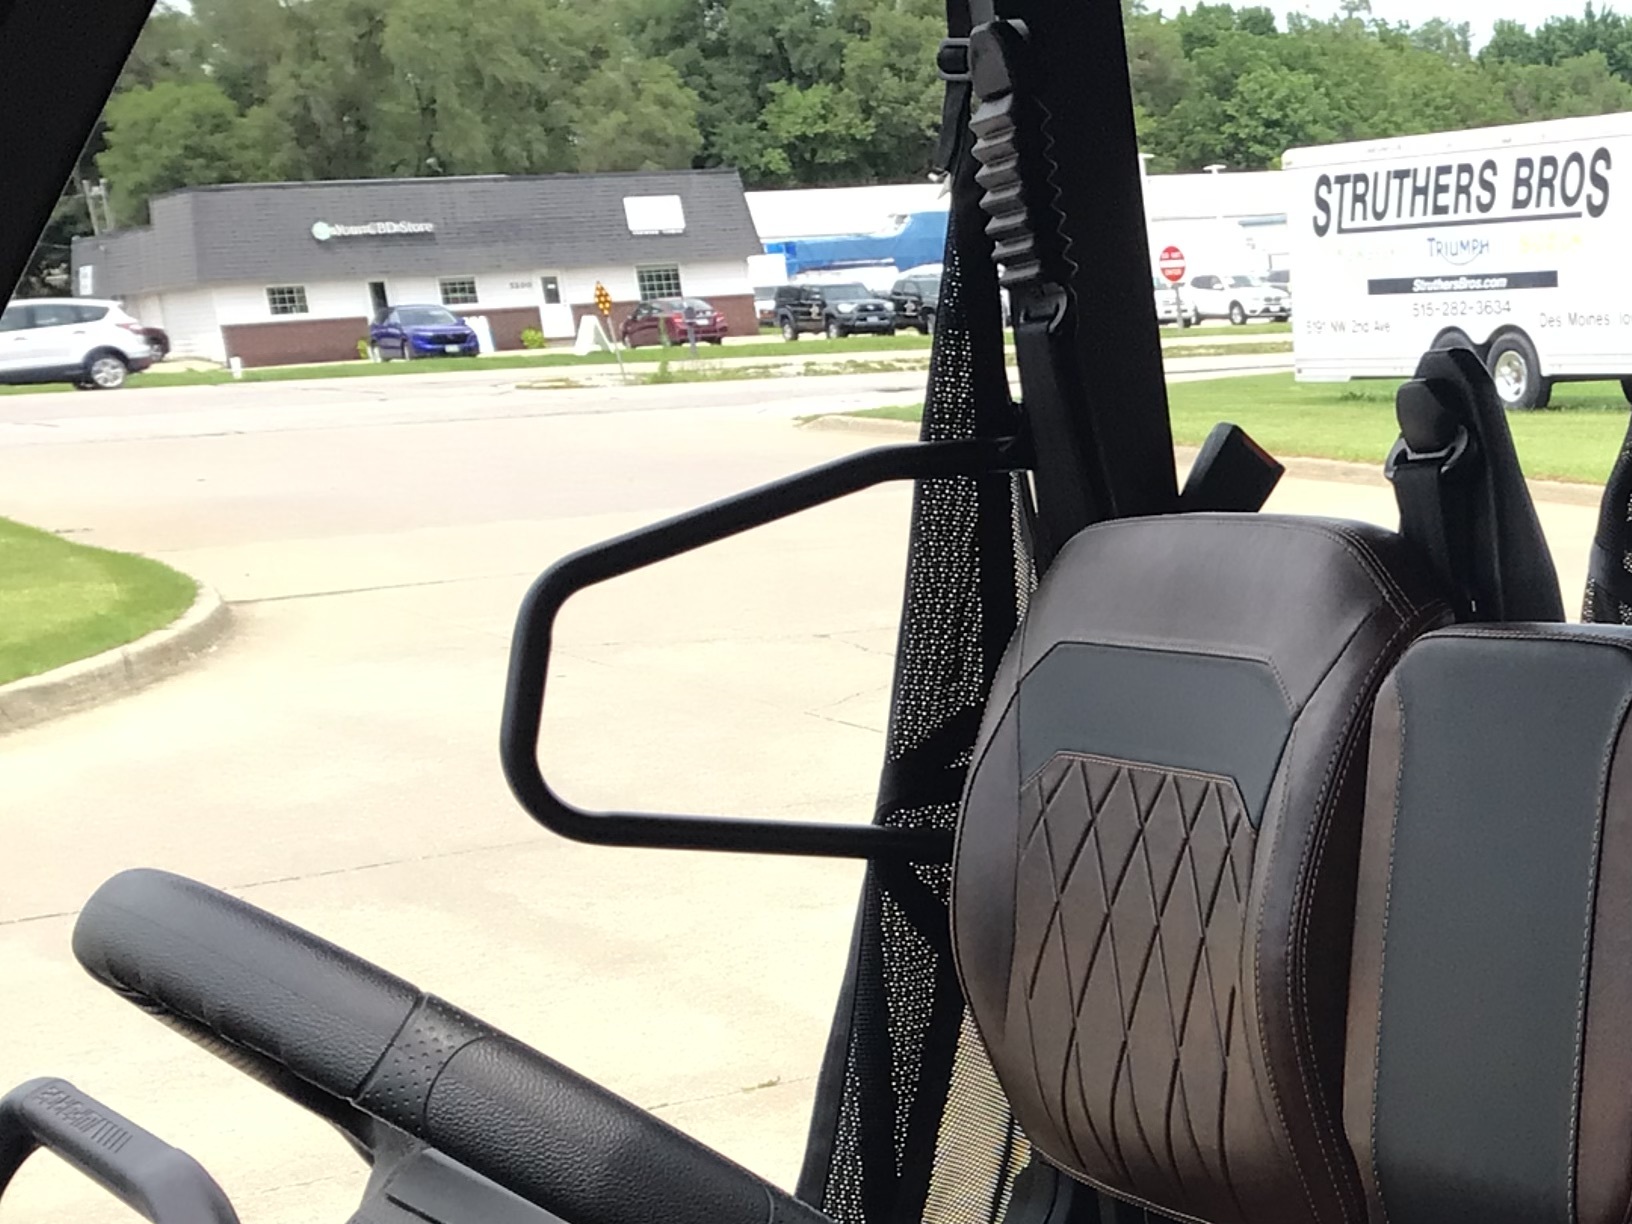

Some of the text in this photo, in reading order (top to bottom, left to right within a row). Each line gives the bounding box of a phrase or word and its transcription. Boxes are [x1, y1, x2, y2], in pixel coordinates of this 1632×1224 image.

[1312, 146, 1612, 238] STRUTHERS BROS
[1427, 237, 1489, 258] TRIUMPH
[1412, 276, 1508, 292] StruthersBros.com
[1412, 299, 1511, 318] 515-282-3634
[1330, 320, 1346, 333] NW
